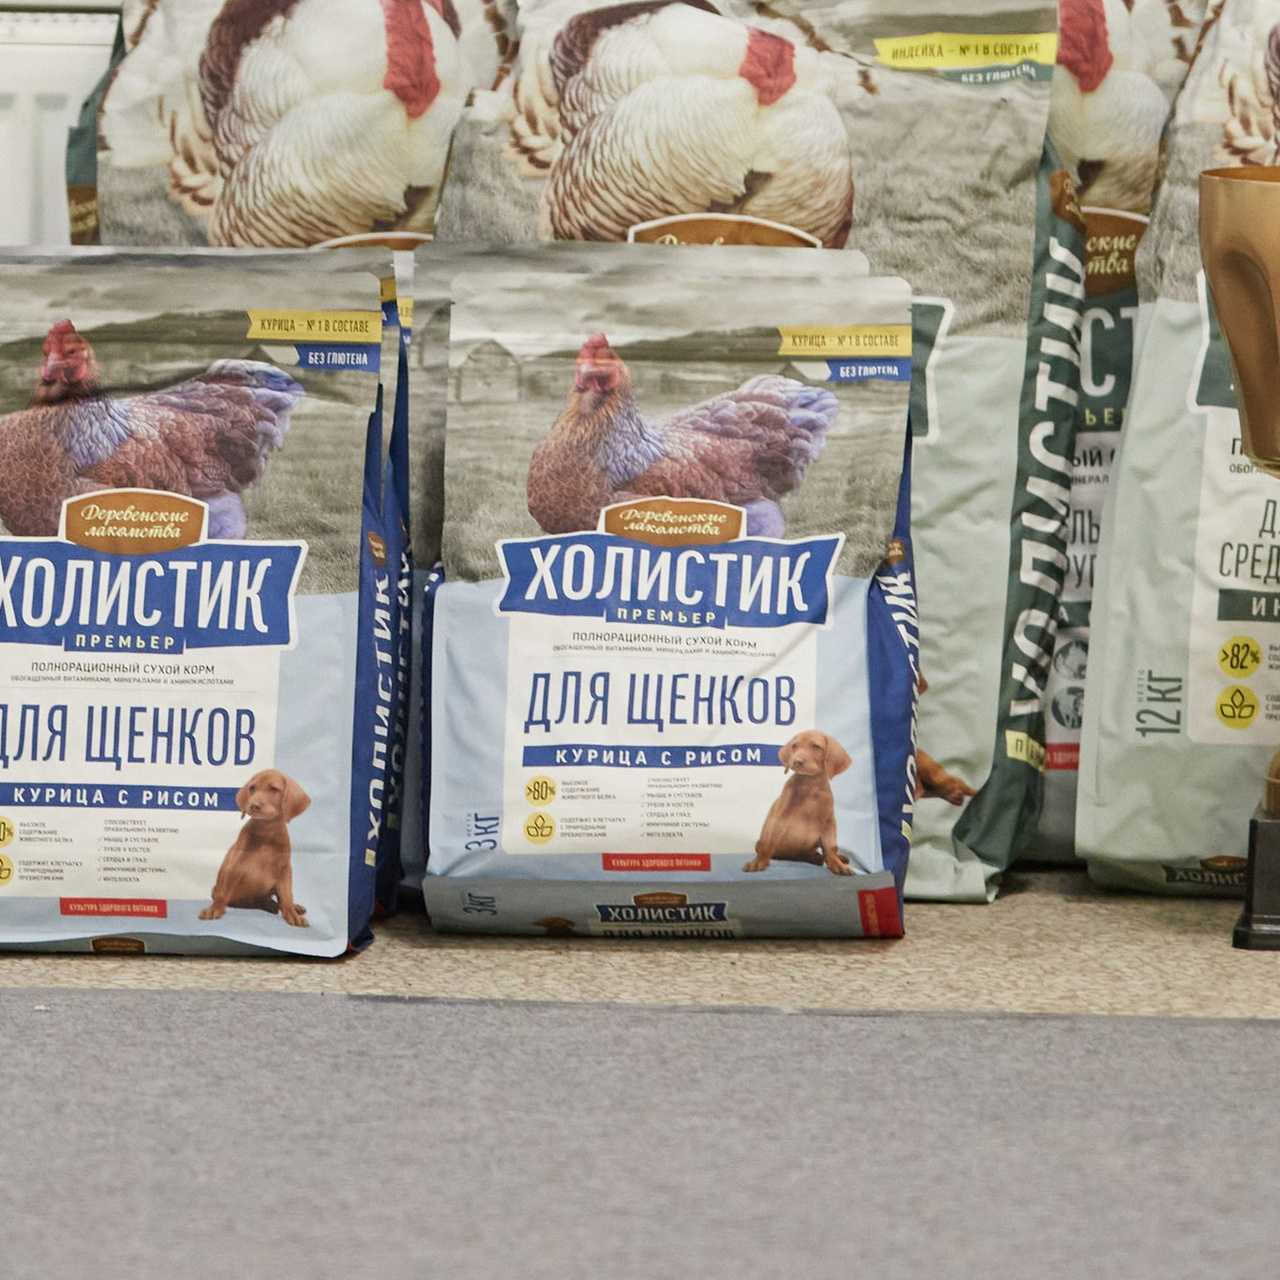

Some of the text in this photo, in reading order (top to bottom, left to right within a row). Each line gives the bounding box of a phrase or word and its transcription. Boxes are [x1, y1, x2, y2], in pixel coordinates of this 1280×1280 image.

[892, 44, 944, 60] ИНДЕЙКА
[983, 45, 990, 56] В
[961, 73, 983, 83] БЕЗ
[1086, 234, 1137, 252] ские
[1087, 251, 1129, 275] тва
[260, 318, 296, 332] КУРИЦА
[324, 320, 330, 332] В
[332, 320, 370, 333] СОСТАВЕ
[791, 334, 826, 347] КУРИЦА
[855, 335, 861, 346] В
[863, 334, 900, 347] СОСТАВЕ
[308, 351, 368, 366] БЕЗ ГЛЮТЕНА
[839, 365, 899, 378] БЕЗ ГЛЮТЕНА
[81, 503, 189, 524] Деревенские
[619, 508, 727, 524] Деревенские
[84, 519, 183, 539] лакомства
[624, 520, 722, 537] лакомства
[1219, 542, 1280, 584] СРЕД
[524, 543, 812, 615] ХОЛИСТИК
[617, 607, 717, 625] ПРЕМЬЕР
[75, 633, 175, 651] ПРЕМЬЕР
[572, 631, 758, 650] ПОЛНОРАЦИОННЫЙ СУХОЙ КОРМ
[1221, 643, 1260, 670] >82%
[31, 661, 216, 676] ПОЛНОРАЦИОННЫЙ СУХОЙ КОРМ
[523, 671, 797, 734] ДЛЯ ЩЕНКОВ
[1135, 669, 1183, 737] 12 КГ
[84, 704, 257, 772] ЩЕНКОВ
[555, 747, 762, 767] КУРИЦА С РИСОМ
[13, 786, 219, 808] КУРИЦА С РИСОМ
[526, 780, 556, 801] >80%
[464, 812, 500, 851] 3 КГ
[1175, 871, 1245, 884] ХОЛИС
[608, 905, 716, 921] ХОЛИСТИК
